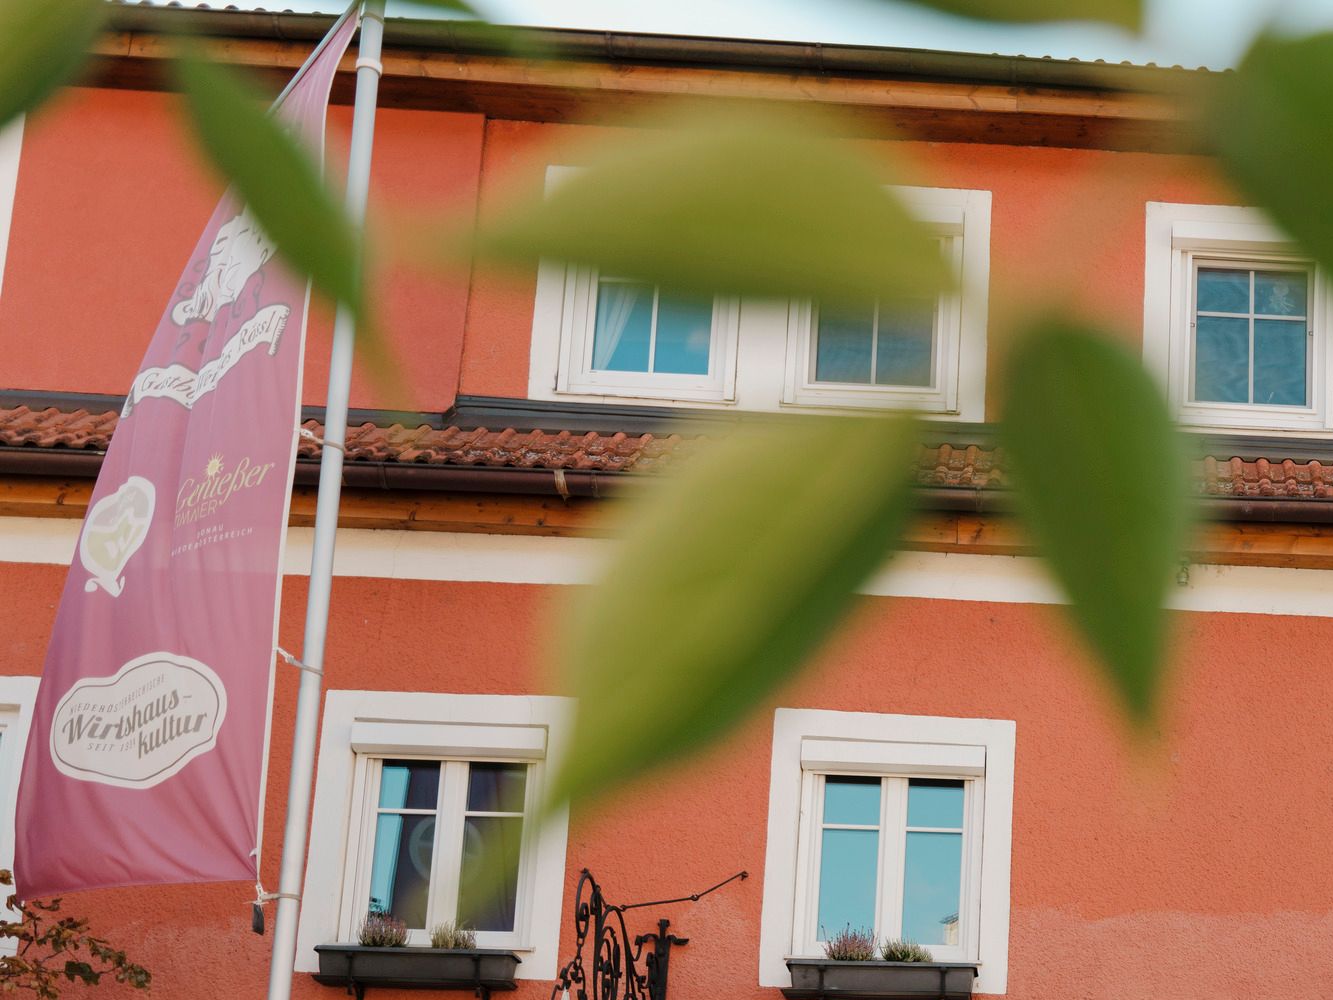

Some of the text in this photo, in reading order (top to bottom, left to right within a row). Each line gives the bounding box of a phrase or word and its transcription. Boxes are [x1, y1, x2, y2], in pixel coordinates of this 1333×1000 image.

[176, 457, 271, 514] Genießer
[87, 742, 116, 751] SEIT
[138, 712, 208, 760] kultur
